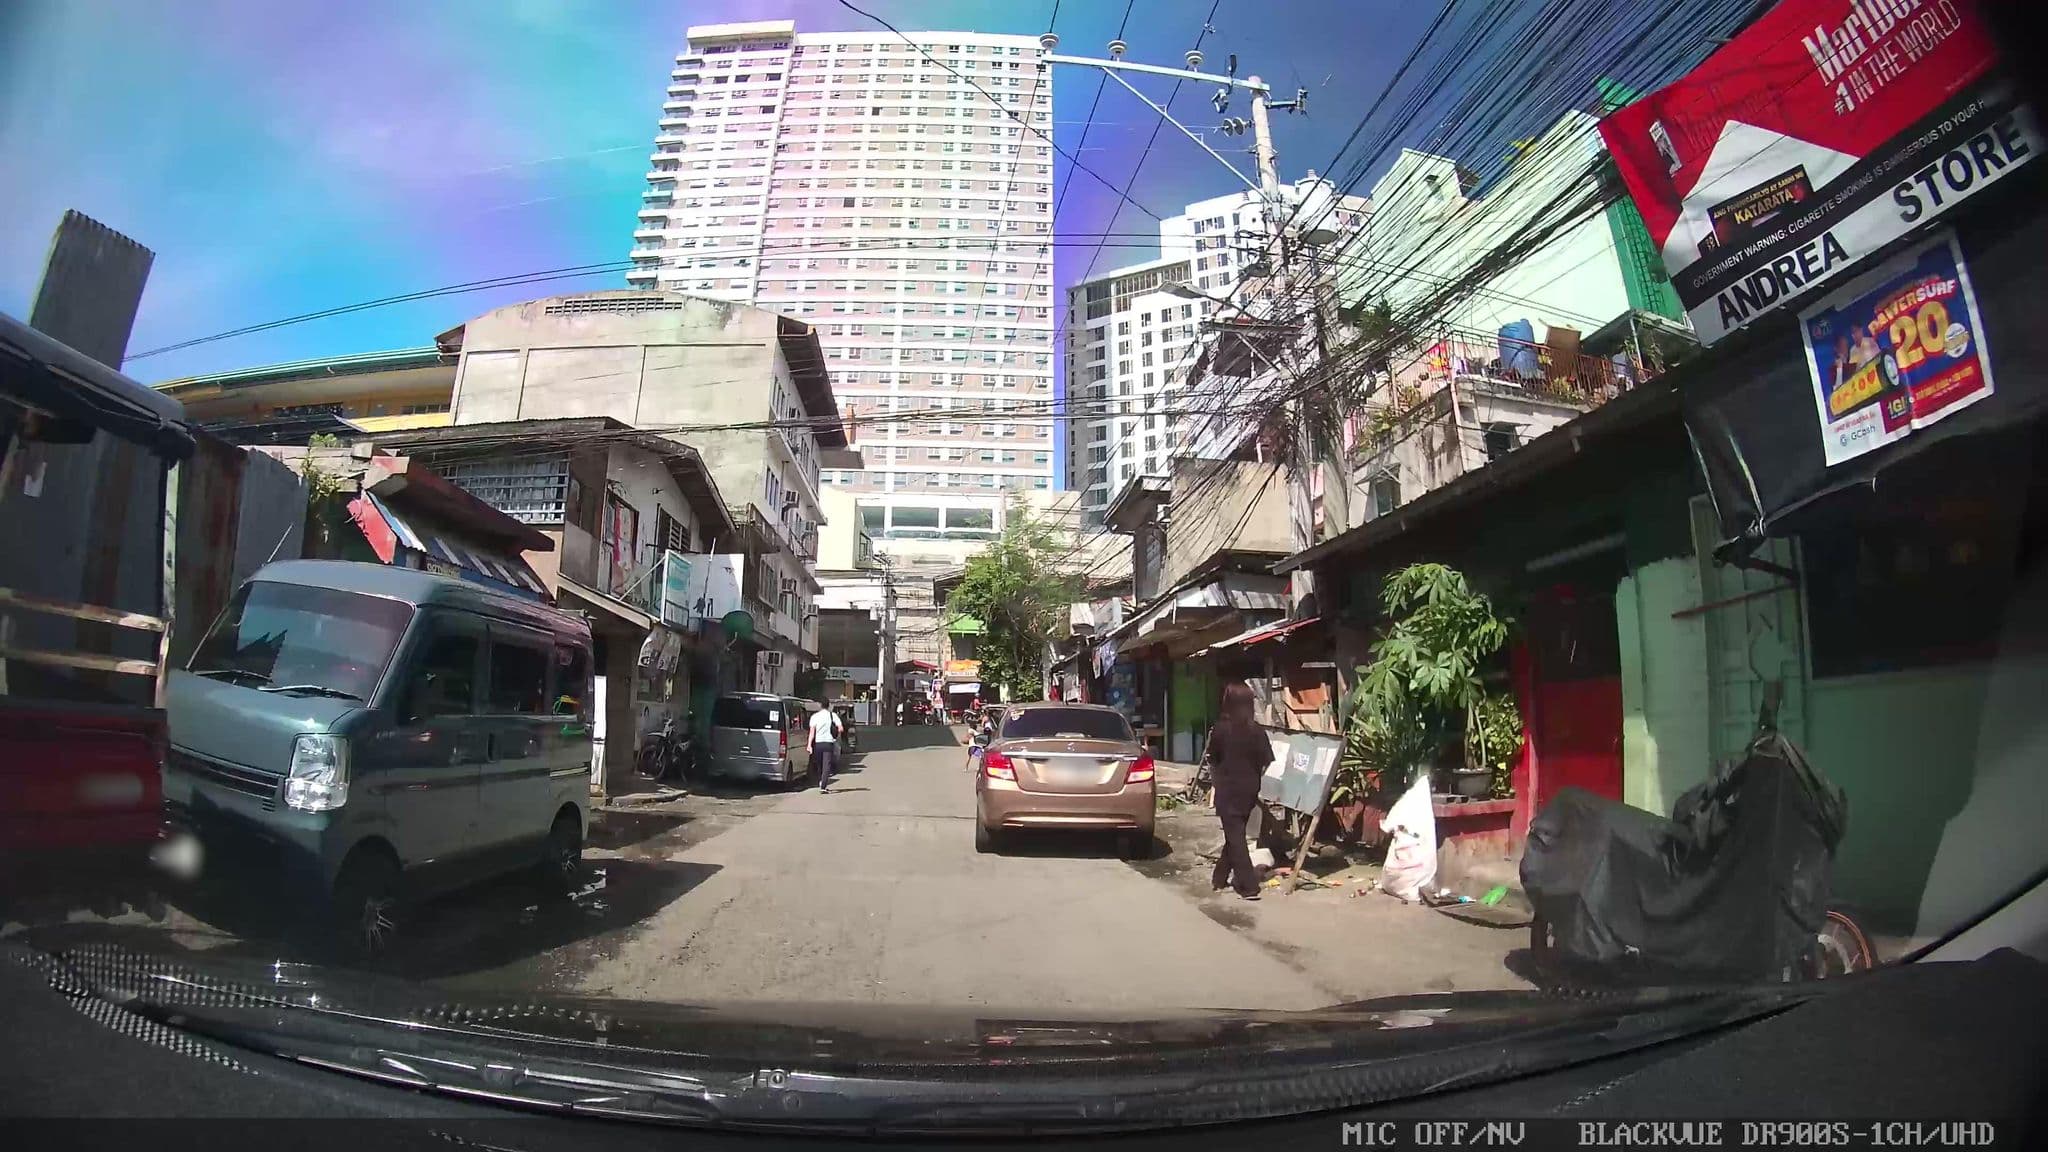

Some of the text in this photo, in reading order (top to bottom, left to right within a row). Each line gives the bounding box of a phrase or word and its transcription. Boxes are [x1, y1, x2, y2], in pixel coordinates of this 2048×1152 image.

[1801, 0, 1921, 86] Marlbo
[1834, 82, 1855, 116] #1
[1848, 66, 1875, 103] IN
[1863, 40, 1907, 87] THE
[1892, 0, 1961, 63] WORLD
[1693, 249, 1744, 289] GOVERNMENT
[1743, 228, 1788, 258] WARNING:
[1787, 200, 1835, 234] CIGARETTE
[1834, 171, 1873, 205] SMOKING
[1872, 164, 1883, 178] IS
[1938, 119, 1953, 136] TO
[1952, 103, 1978, 127] YOUR
[1717, 231, 1850, 330] ANDREA
[1893, 114, 2031, 223] STORE
[1734, 188, 1794, 225] KATARATA
[1889, 301, 1949, 369] 20
[1851, 424, 1876, 440] GCash
